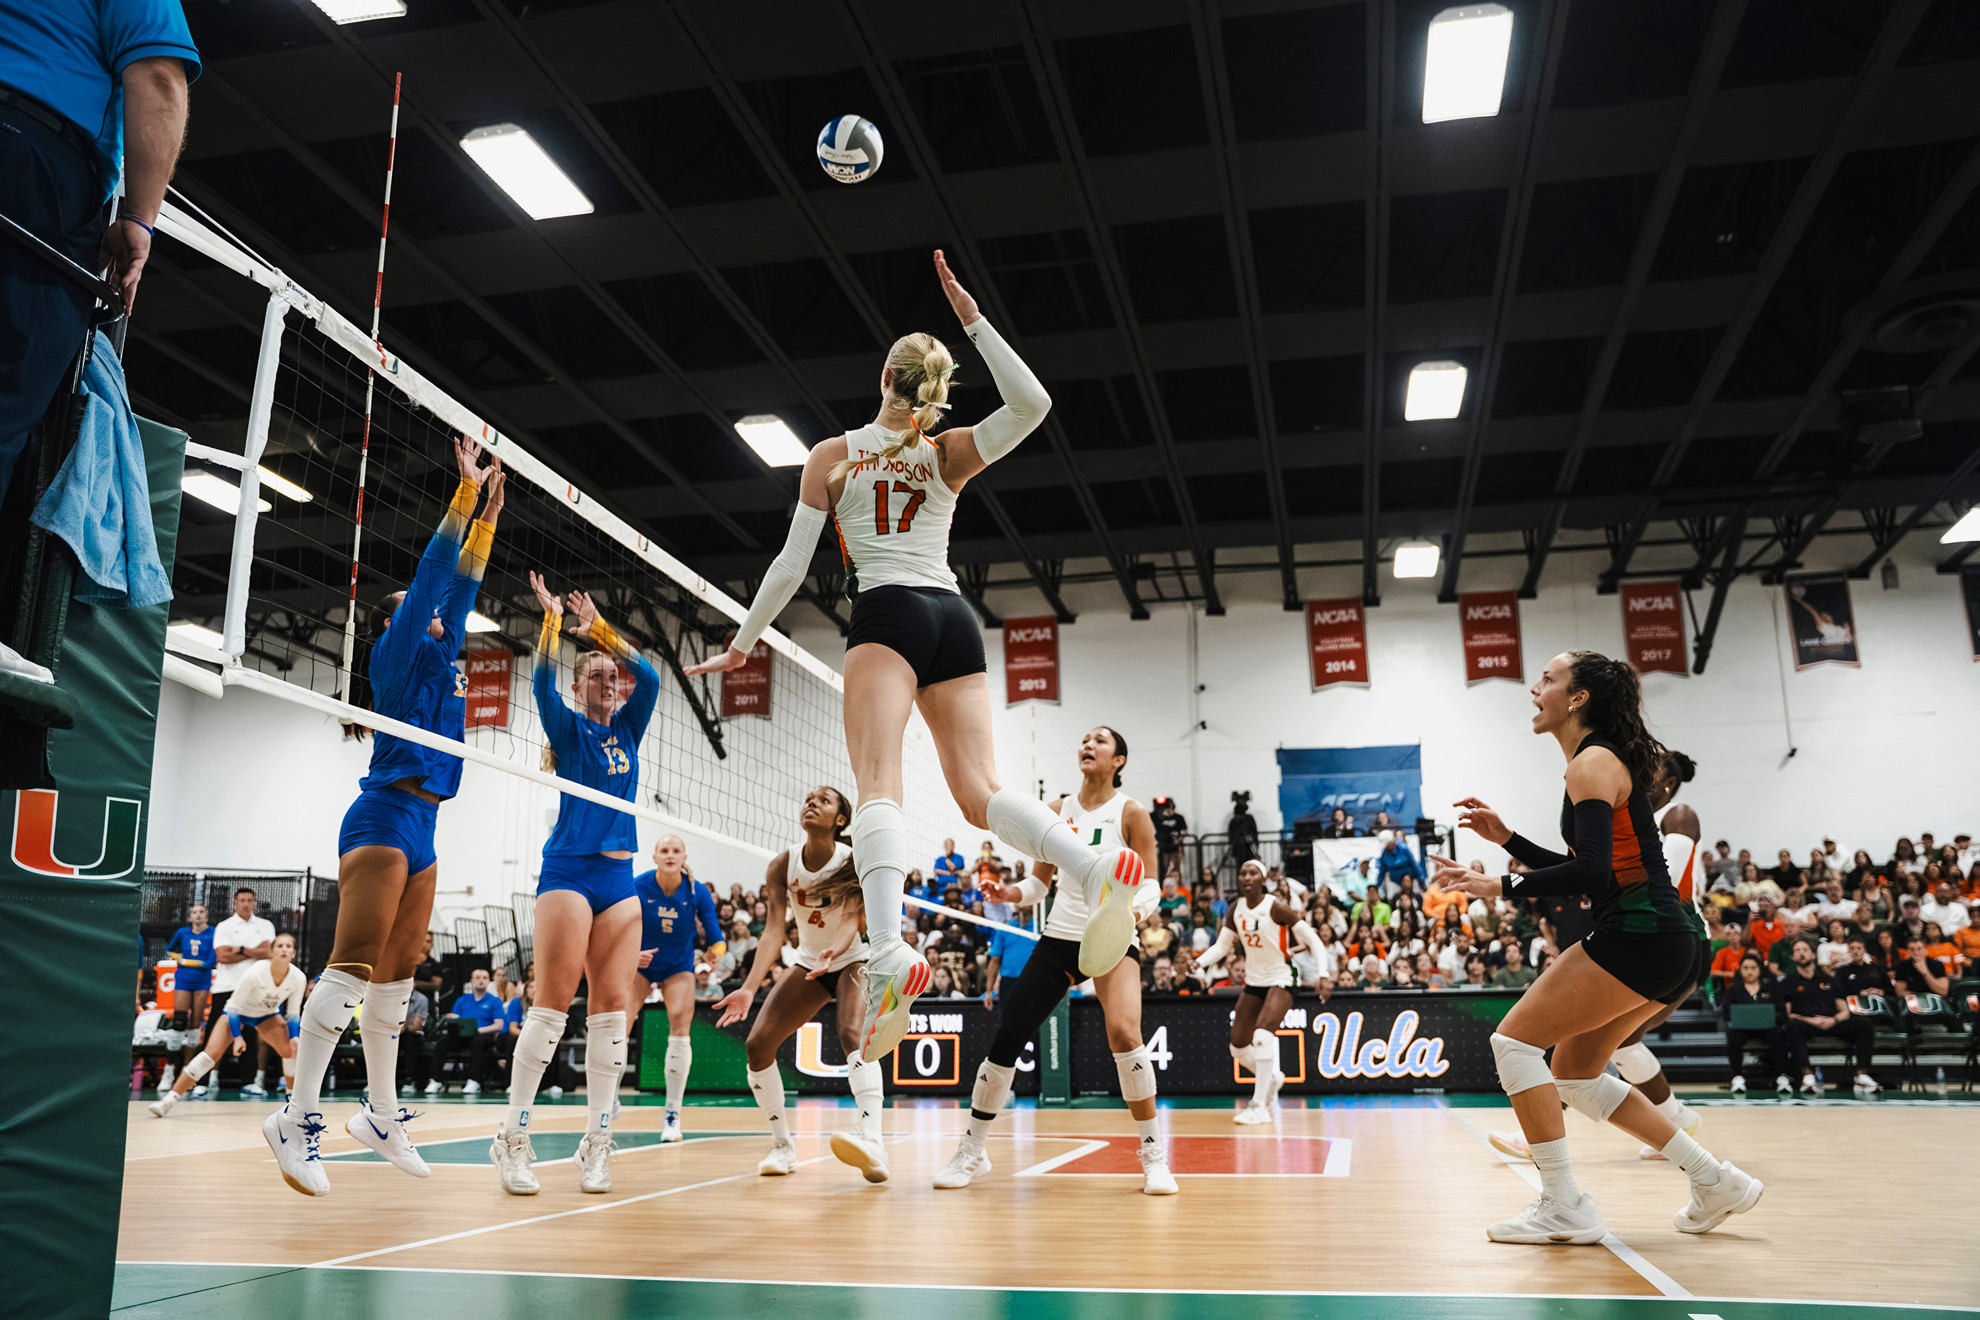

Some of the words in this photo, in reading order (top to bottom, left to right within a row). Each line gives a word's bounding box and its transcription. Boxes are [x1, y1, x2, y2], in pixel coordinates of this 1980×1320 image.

[872, 480, 927, 536] 17
[1466, 605, 1512, 620] NCAA
[1629, 595, 1675, 612] NCAA
[1313, 608, 1358, 626] NCAA
[1008, 627, 1053, 644] NCAA
[1477, 656, 1509, 669] 2015
[1641, 650, 1671, 661] 2017
[1325, 660, 1356, 674] 2014
[1019, 678, 1047, 692] 2013
[603, 747, 630, 775] 13
[11, 788, 142, 880] U
[797, 888, 832, 909] U
[661, 918, 674, 934] 5
[808, 910, 826, 929] 4
[1242, 919, 1260, 931] U
[1244, 933, 1264, 948] 22
[159, 972, 176, 993] G
[1847, 994, 1886, 1016] U
[1905, 994, 1942, 1015] U
[930, 1013, 964, 1033] WON
[1146, 1025, 1174, 1071] 4
[1312, 1009, 1451, 1080] Ucla
[914, 1037, 942, 1077] 0
